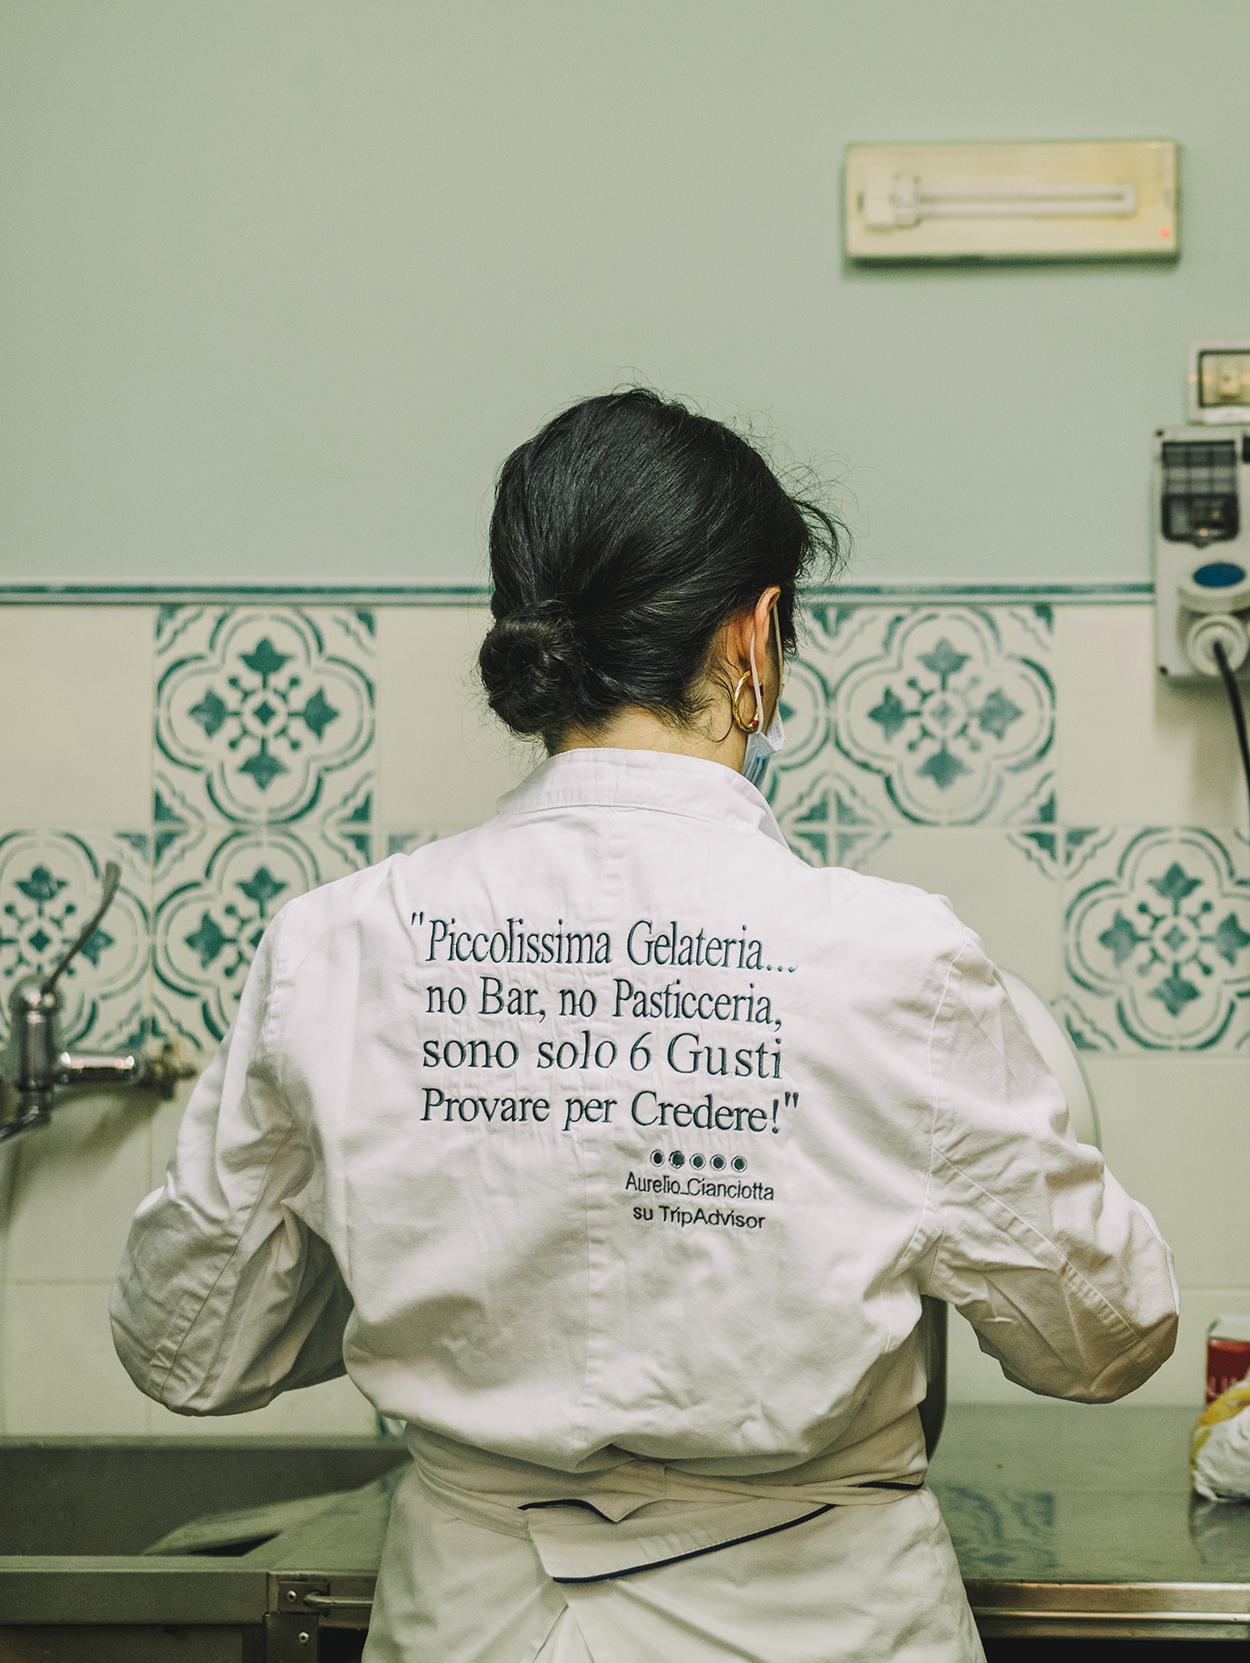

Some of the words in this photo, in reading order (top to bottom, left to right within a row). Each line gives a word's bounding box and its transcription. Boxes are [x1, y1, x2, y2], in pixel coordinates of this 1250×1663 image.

[411, 911, 613, 966] "Piccolissima
[626, 919, 797, 974] Gelateria...
[425, 985, 467, 1015] no
[478, 976, 546, 1024] Bar,
[558, 987, 597, 1018] no
[611, 977, 782, 1033] Pasticceria,
[422, 1039, 520, 1069] sono
[536, 1030, 618, 1070] solo
[629, 1031, 653, 1072] 6
[666, 1032, 783, 1080] Gusti
[420, 1087, 551, 1123] Provare
[561, 1097, 619, 1132] per
[630, 1089, 800, 1135] Credere!"
[625, 1171, 775, 1202] Aurelio_Cianciotta
[632, 1206, 654, 1222] su
[658, 1205, 767, 1230] TripAdvisor
